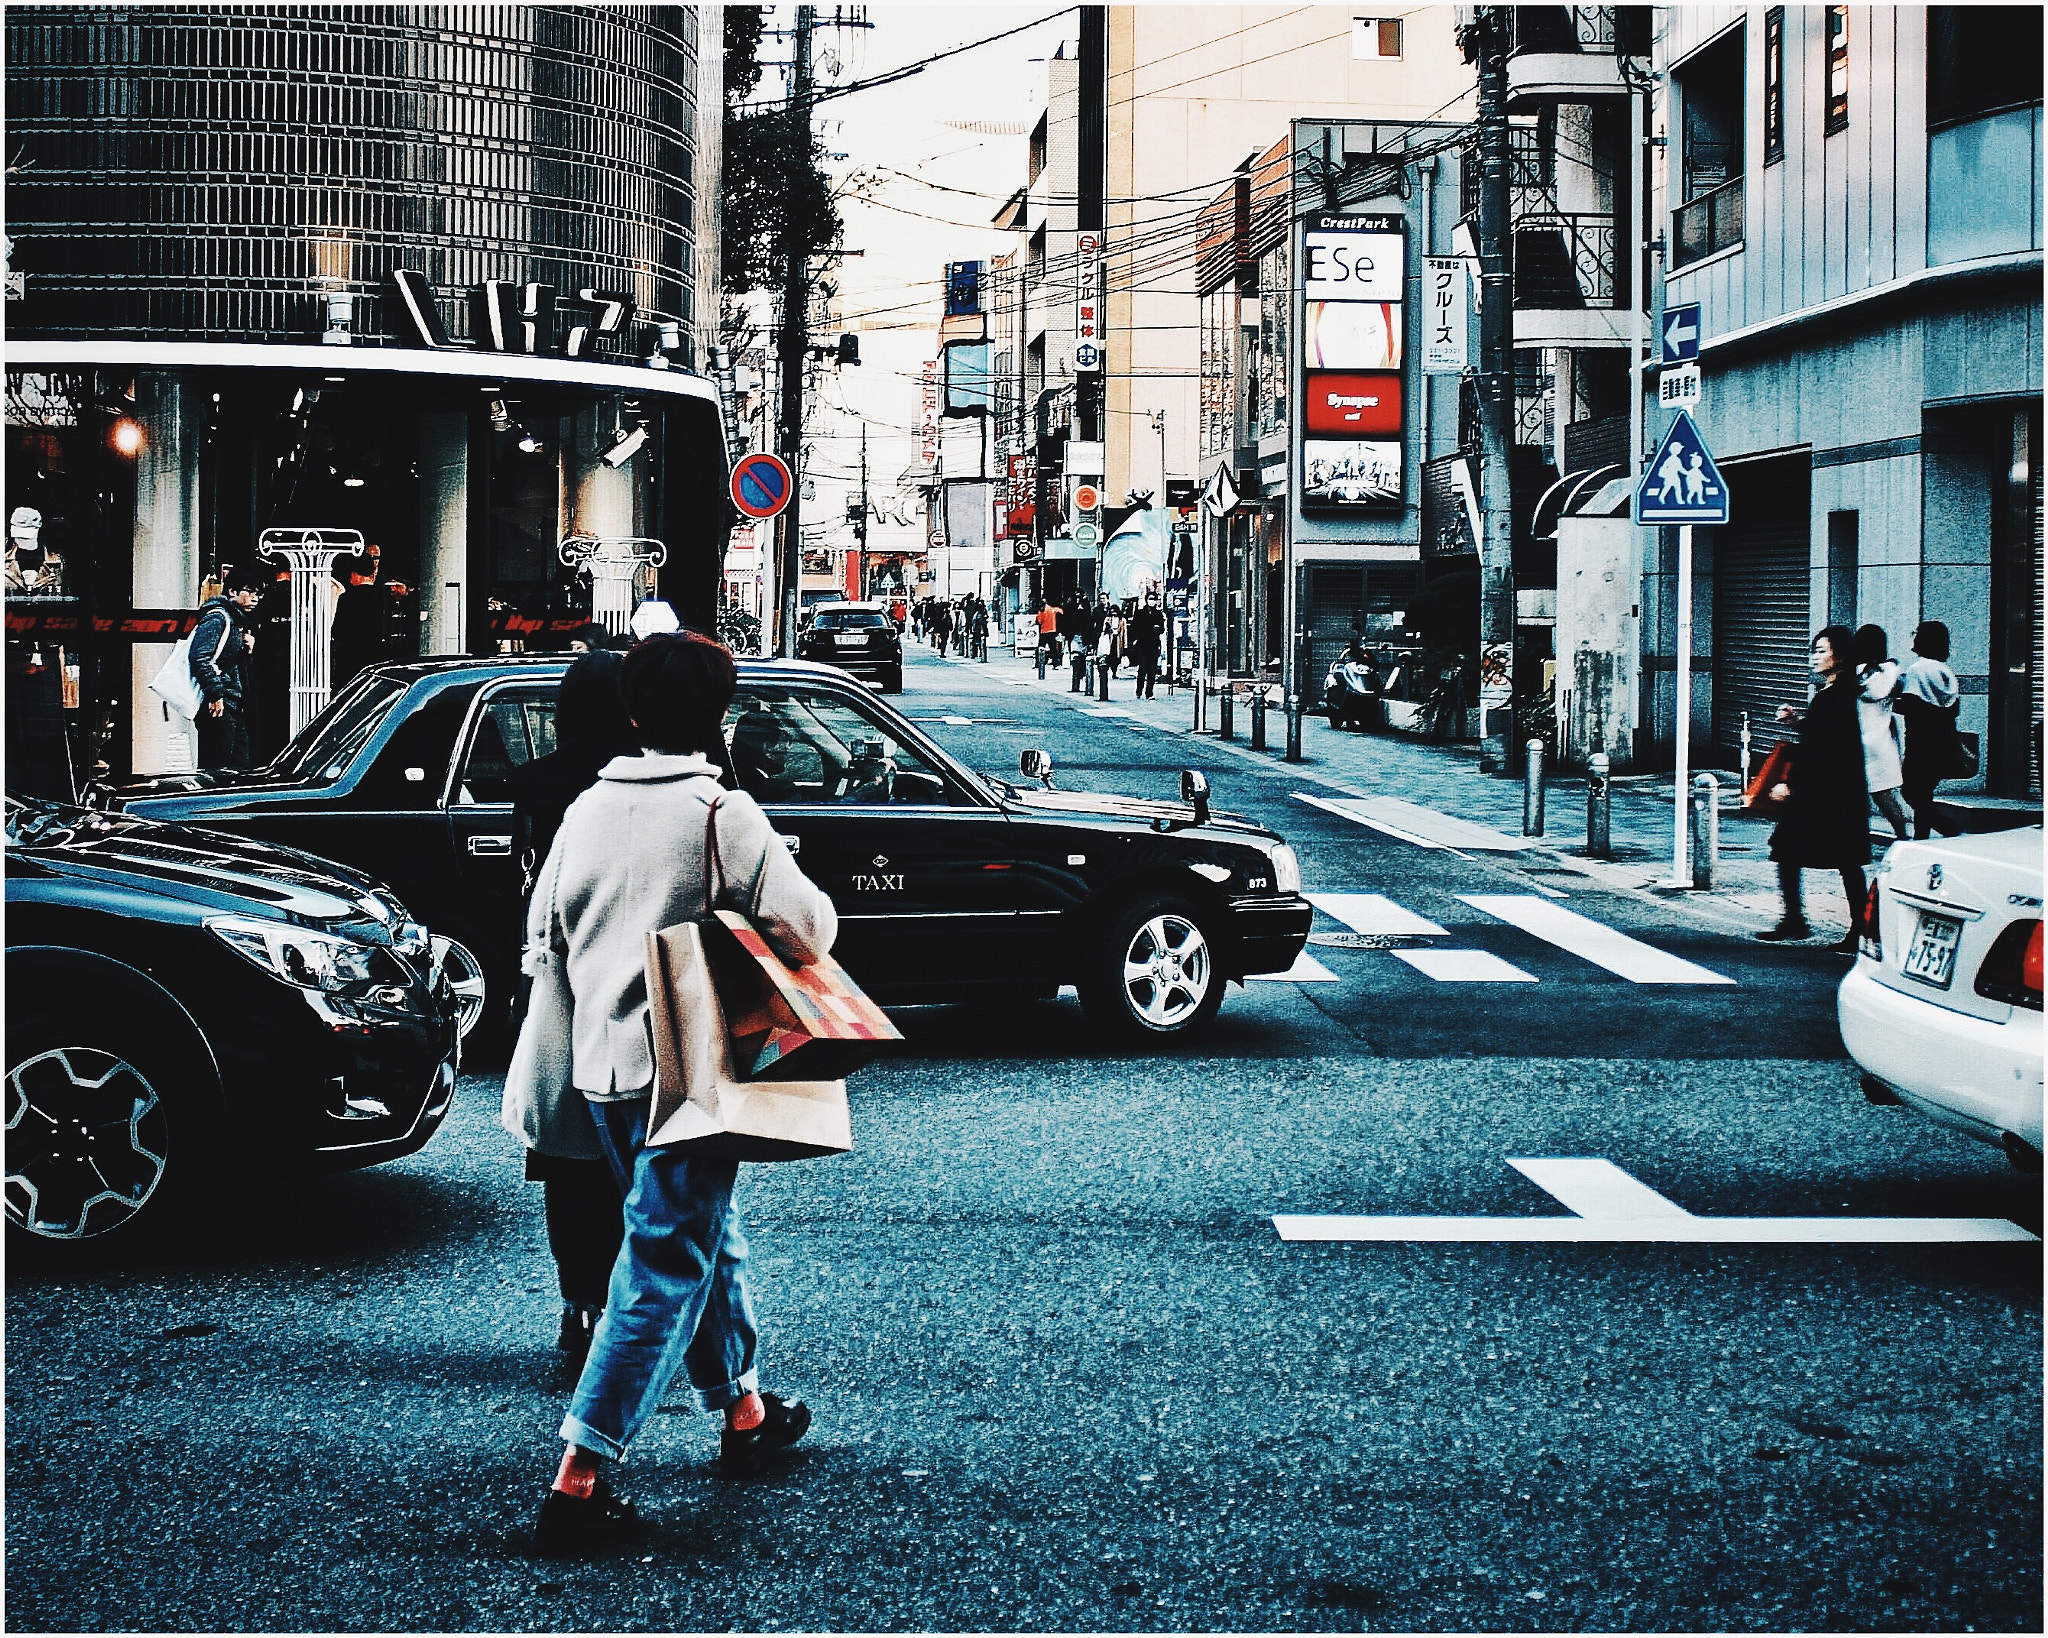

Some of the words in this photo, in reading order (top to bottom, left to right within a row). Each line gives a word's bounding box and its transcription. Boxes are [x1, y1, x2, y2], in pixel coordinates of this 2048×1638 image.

[1320, 217, 1390, 229] CrestPark
[1436, 273, 1454, 344] クルーズ
[851, 874, 905, 891] TAXI
